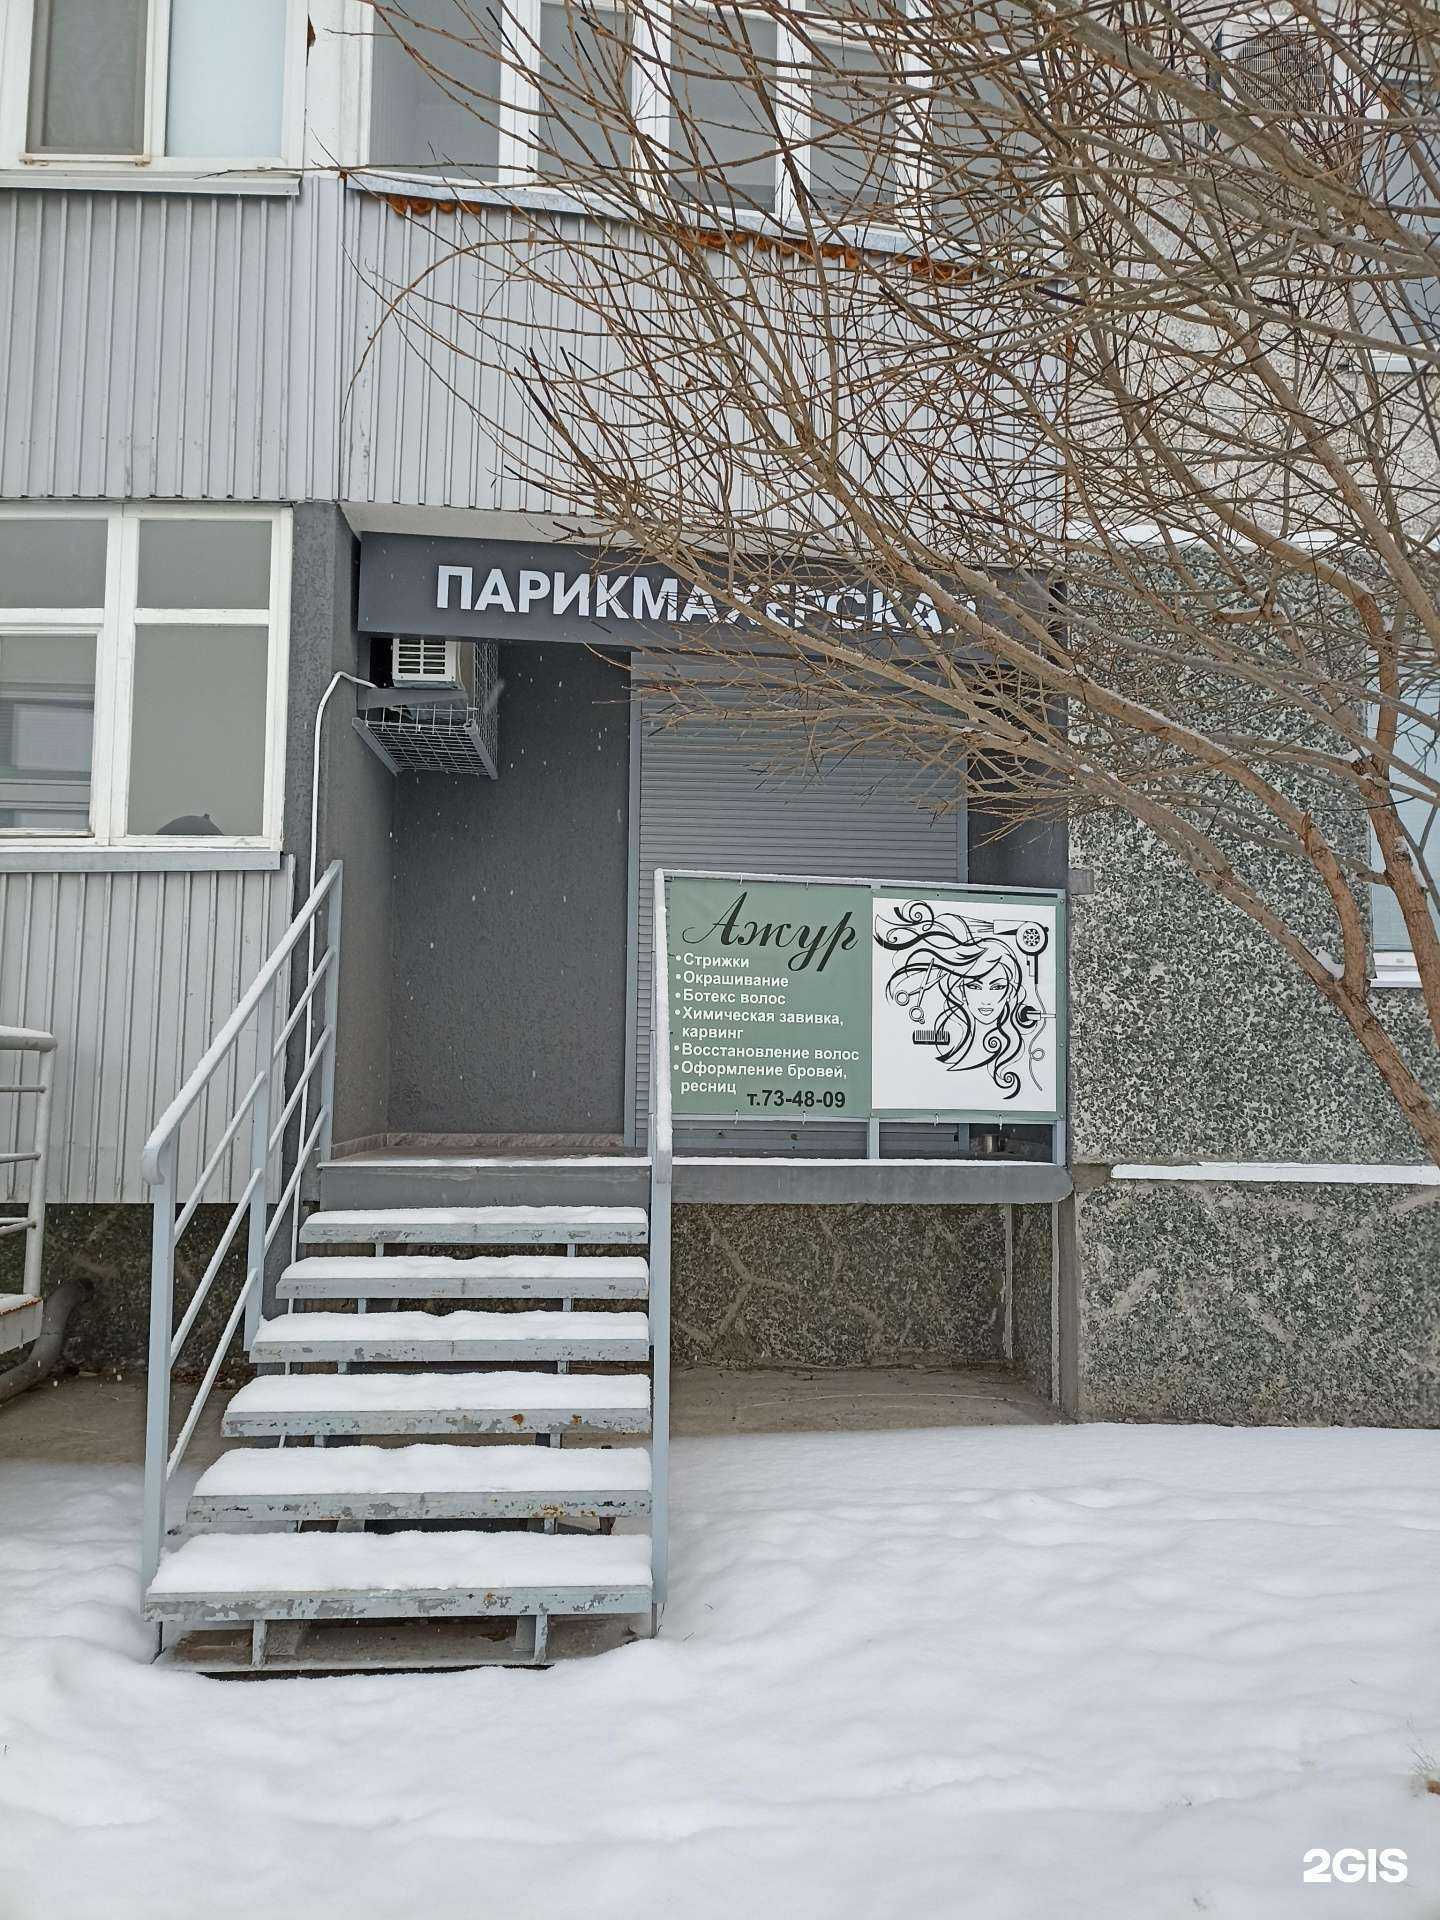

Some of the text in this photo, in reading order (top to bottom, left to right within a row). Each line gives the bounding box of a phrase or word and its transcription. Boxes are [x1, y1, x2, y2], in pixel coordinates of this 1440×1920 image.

[436, 564, 977, 635] ПАРИКМАХЕРСКА
[682, 891, 859, 972] Ажур
[683, 952, 749, 969] Стрижки
[683, 971, 789, 988] Окрашивание
[683, 989, 786, 1005] Ботекс волос
[682, 1006, 844, 1026] Химическая завивка,
[682, 1026, 744, 1040] карвинг
[682, 1042, 860, 1061] Восстановление волос
[681, 1061, 847, 1080] Оформление бровей,
[680, 1082, 737, 1095] ресниц
[747, 1089, 846, 1108] т.73-48-09
